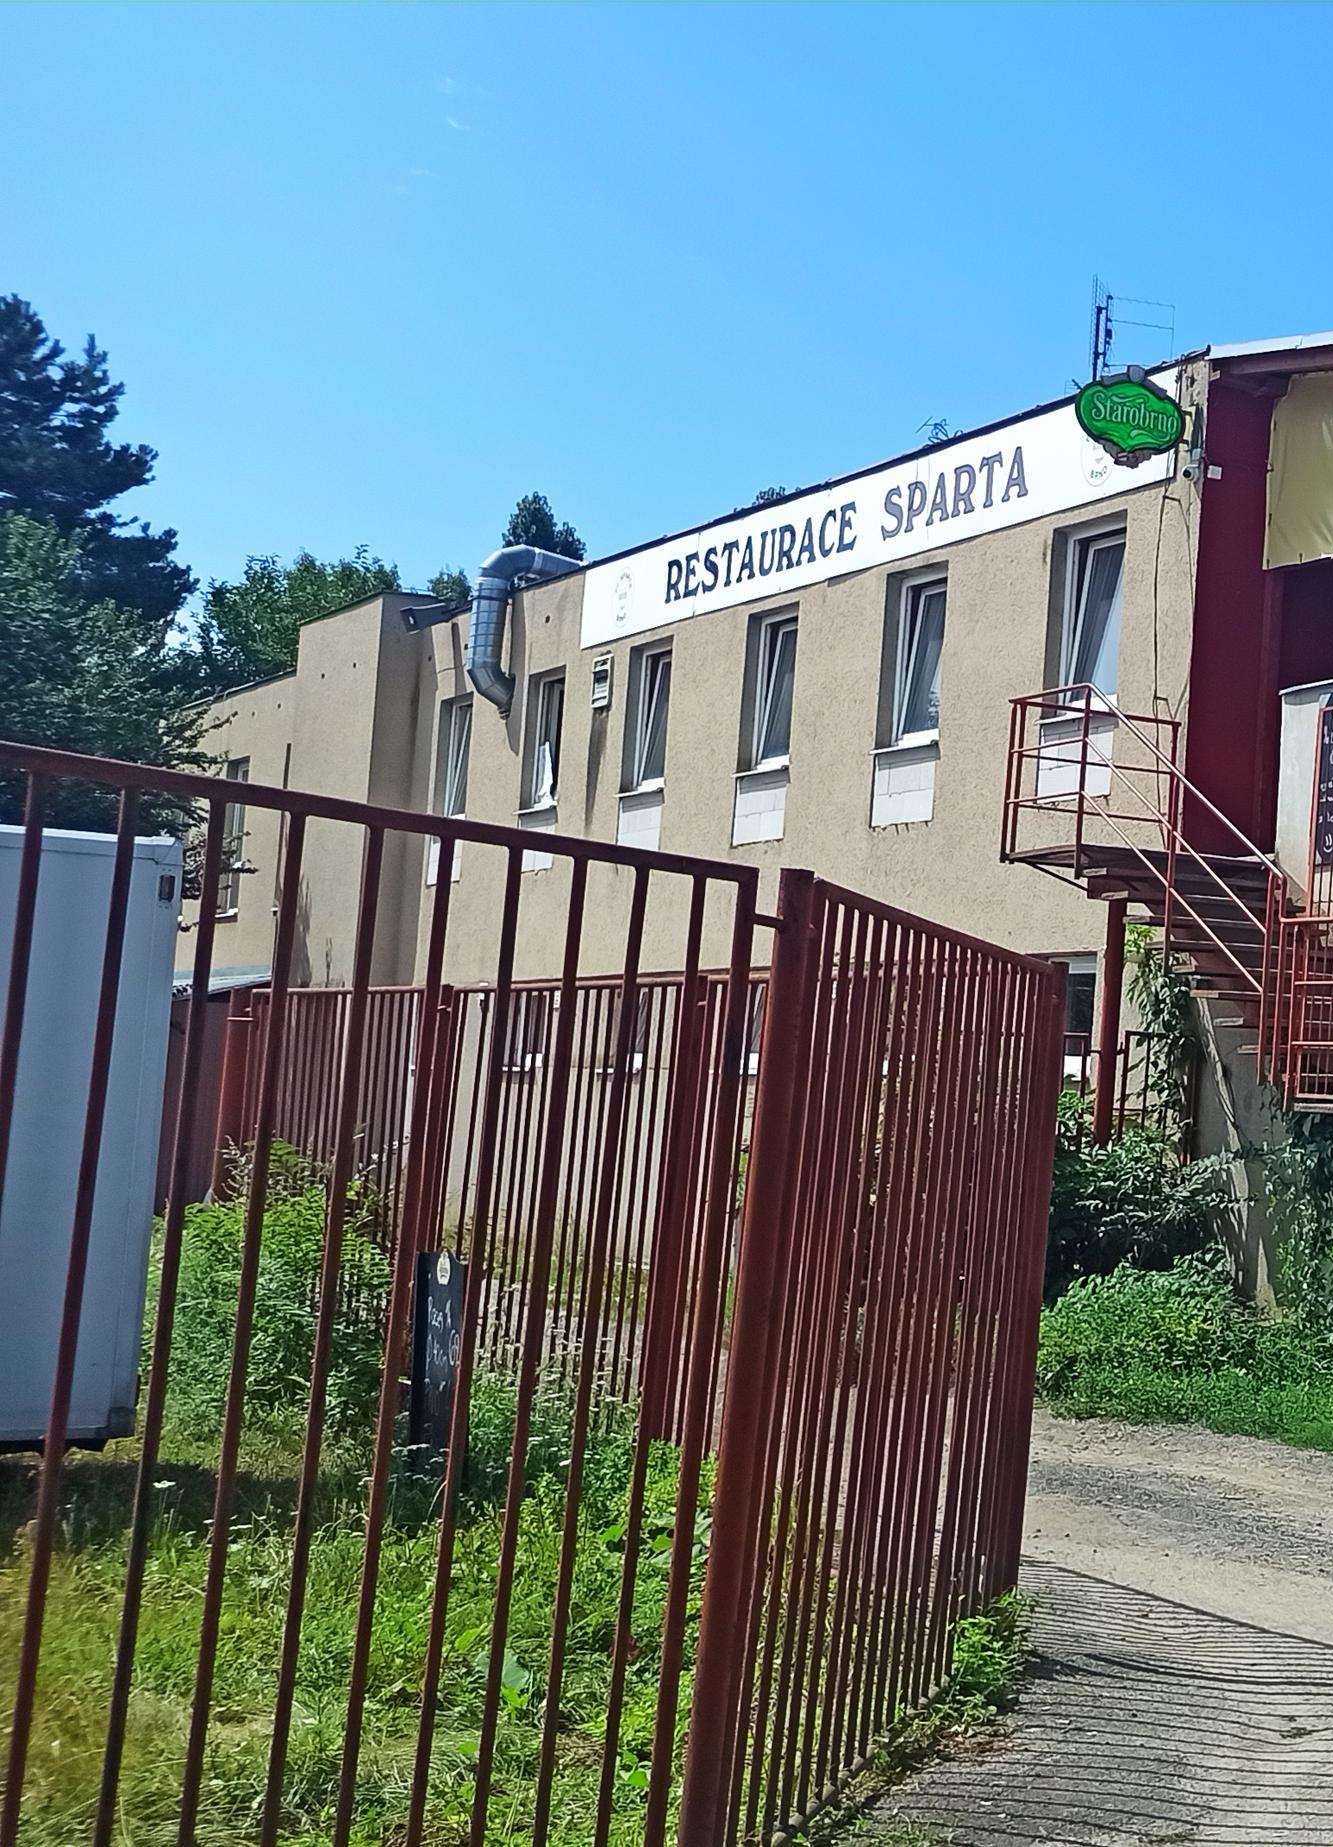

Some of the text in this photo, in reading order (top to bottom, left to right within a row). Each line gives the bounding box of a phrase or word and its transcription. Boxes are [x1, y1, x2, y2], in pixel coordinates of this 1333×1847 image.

[1091, 392, 1177, 437] Starobrno
[663, 502, 858, 605] RESTAURACE
[880, 446, 1029, 540] SPARTA
